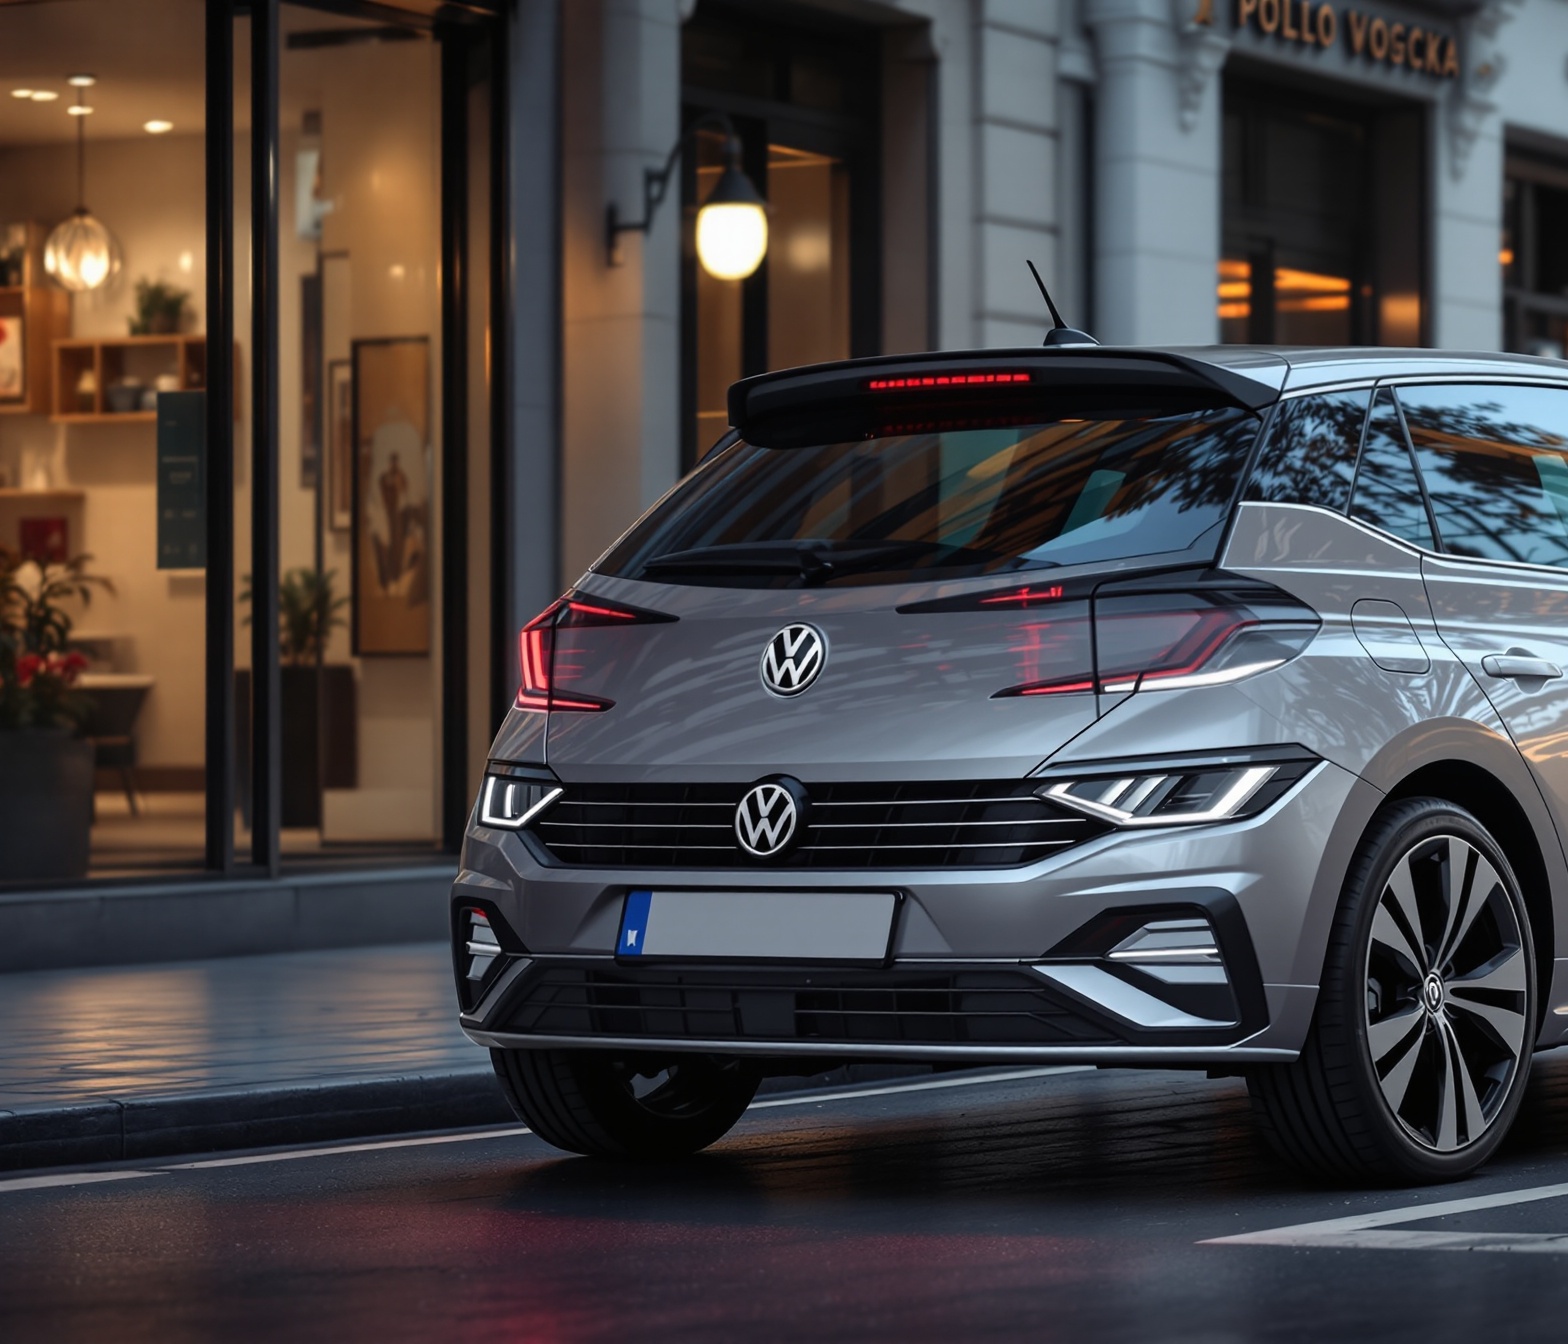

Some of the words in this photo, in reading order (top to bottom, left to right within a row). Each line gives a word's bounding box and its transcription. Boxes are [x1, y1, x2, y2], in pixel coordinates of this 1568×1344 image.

[1239, 0, 1337, 48] POLLO
[762, 623, 824, 691] VW
[735, 784, 797, 856] VW
